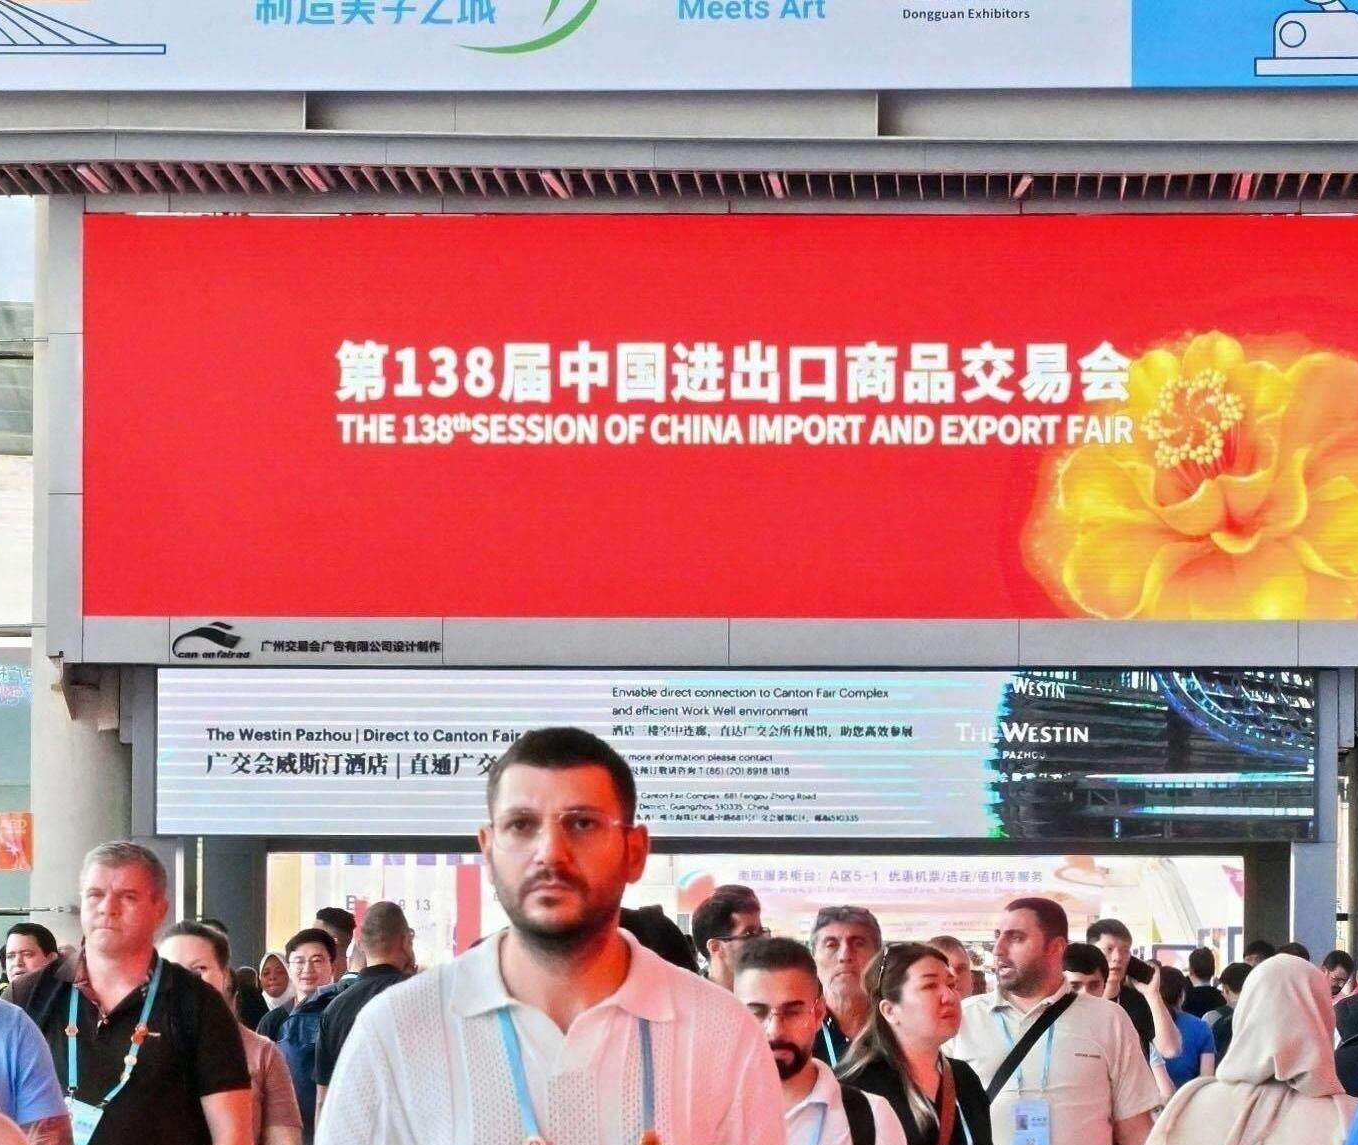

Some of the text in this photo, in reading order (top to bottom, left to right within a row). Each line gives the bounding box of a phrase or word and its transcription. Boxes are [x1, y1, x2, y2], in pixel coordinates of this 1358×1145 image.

[677, 0, 826, 20] Meets Art
[902, 8, 1030, 22] Dongguan Exhibitors
[335, 340, 1132, 404] 第138届中国进出口商品交易会
[336, 413, 396, 445] THE
[472, 413, 598, 445] SESSION
[604, 413, 645, 445] OF
[650, 413, 743, 445] CHINA
[748, 413, 866, 445] IMPORT
[869, 413, 935, 445] AND
[941, 413, 1064, 445] EXPORT
[1067, 413, 1134, 445] FAIR
[612, 686, 889, 700] Enviable direct connection to Canton Fair Complex
[612, 705, 809, 717] and efficient Work Well environment
[206, 728, 522, 743] The Westin Pazhou Direct to Canton Fair
[1000, 721, 1089, 743] WESTIN
[206, 752, 389, 777] 广交会威斯汀酒店
[708, 753, 736, 763] please
[738, 754, 773, 762] contact
